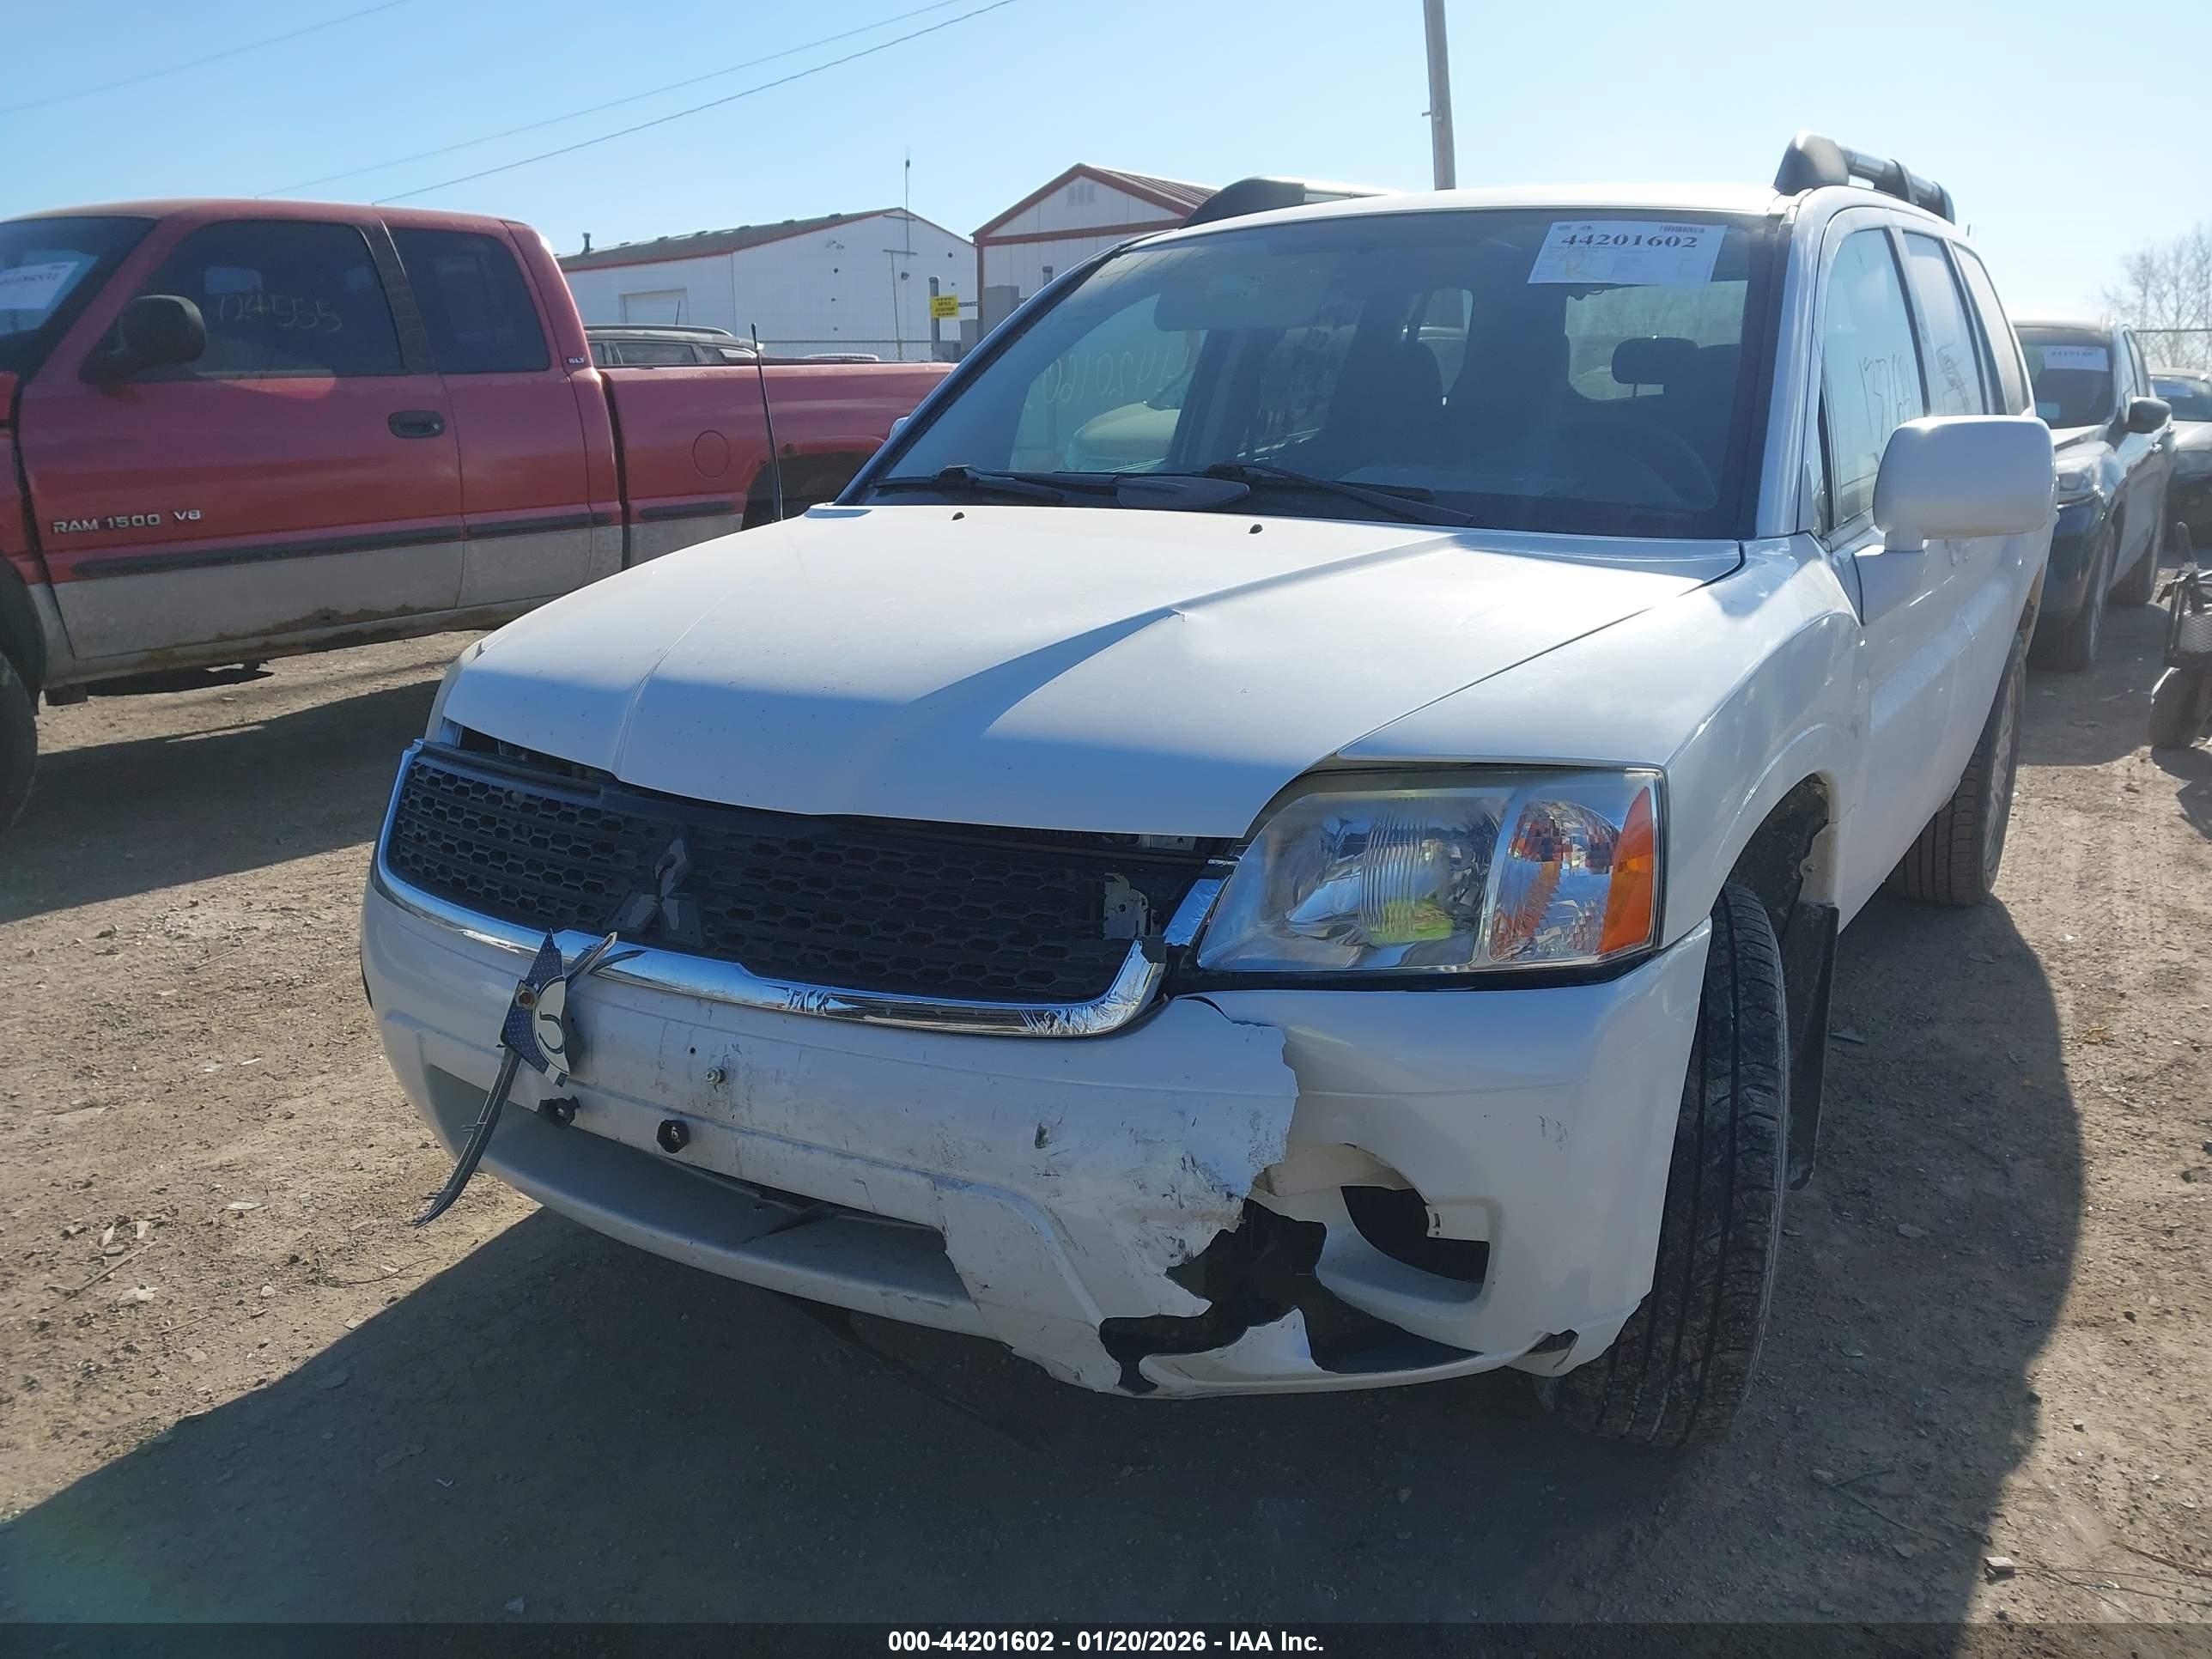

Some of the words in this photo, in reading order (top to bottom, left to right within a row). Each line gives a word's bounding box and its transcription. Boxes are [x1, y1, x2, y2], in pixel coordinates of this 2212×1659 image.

[1561, 234, 1698, 248] 44201602
[53, 519, 99, 533] RAM
[107, 514, 161, 529] 1500
[173, 509, 201, 520] V8
